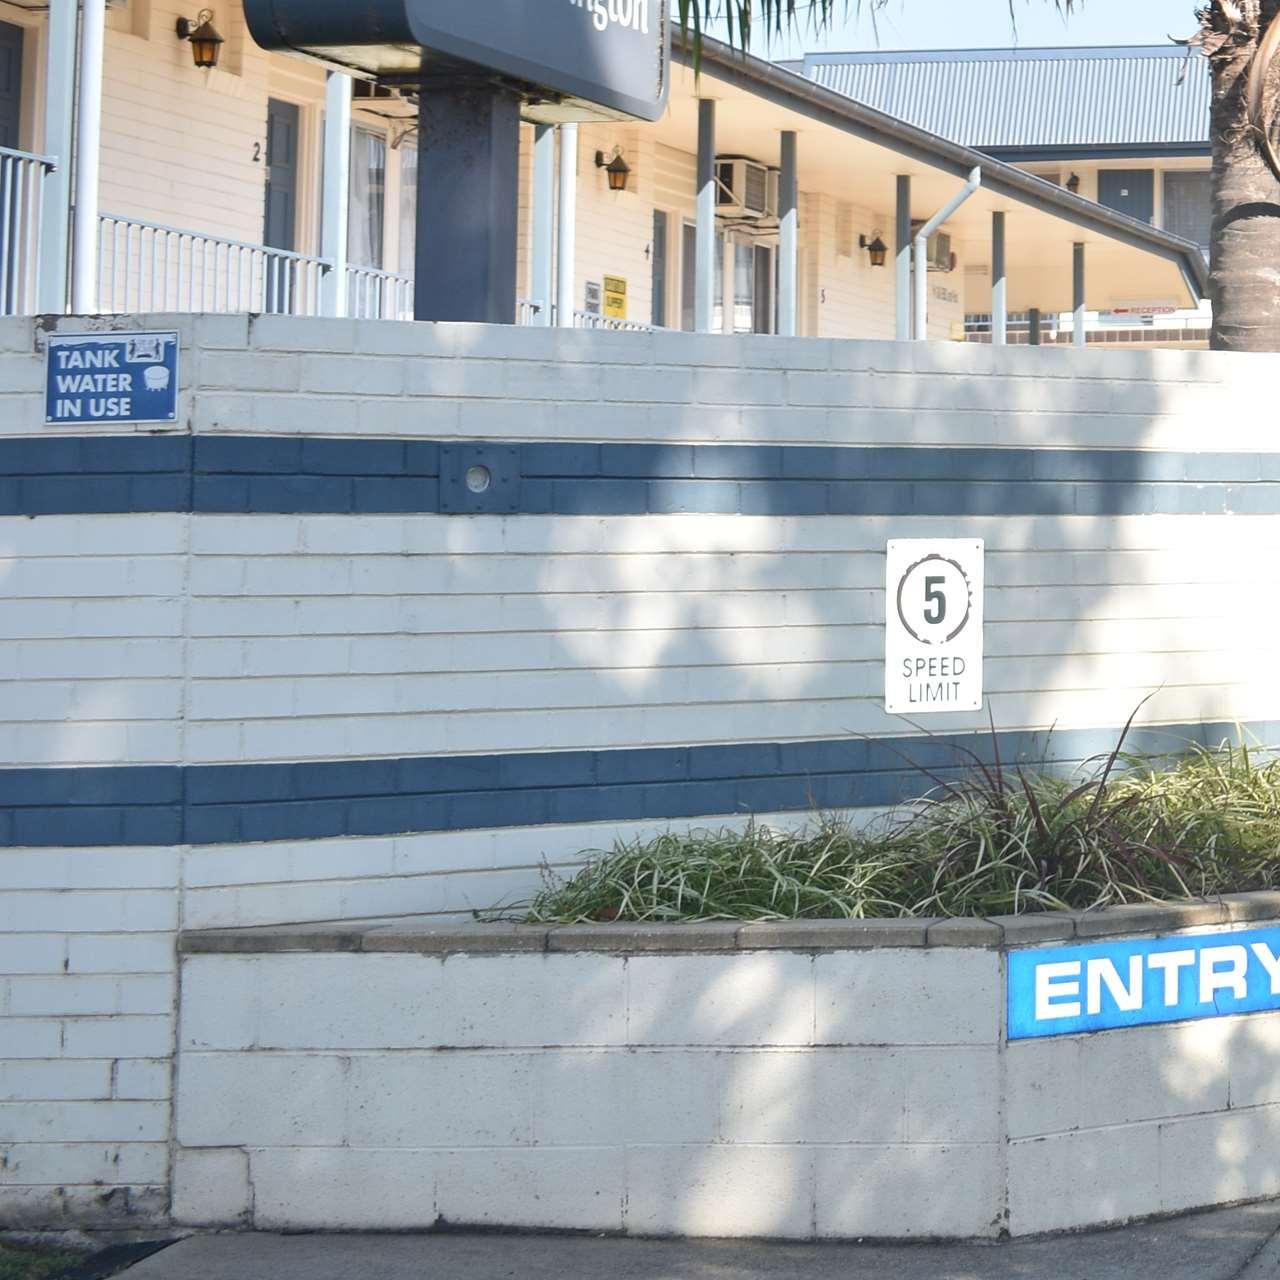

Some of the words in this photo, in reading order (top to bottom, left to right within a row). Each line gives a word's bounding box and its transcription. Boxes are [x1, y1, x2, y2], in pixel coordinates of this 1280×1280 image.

[252, 141, 261, 162] 2
[1130, 306, 1176, 314] RECEPTION
[57, 350, 120, 369] TANK
[56, 373, 133, 393] WATER
[56, 399, 82, 418] IN
[89, 397, 131, 417] USE
[923, 575, 947, 625] 5
[903, 657, 966, 678] SPEED
[909, 682, 960, 702] LIMIT
